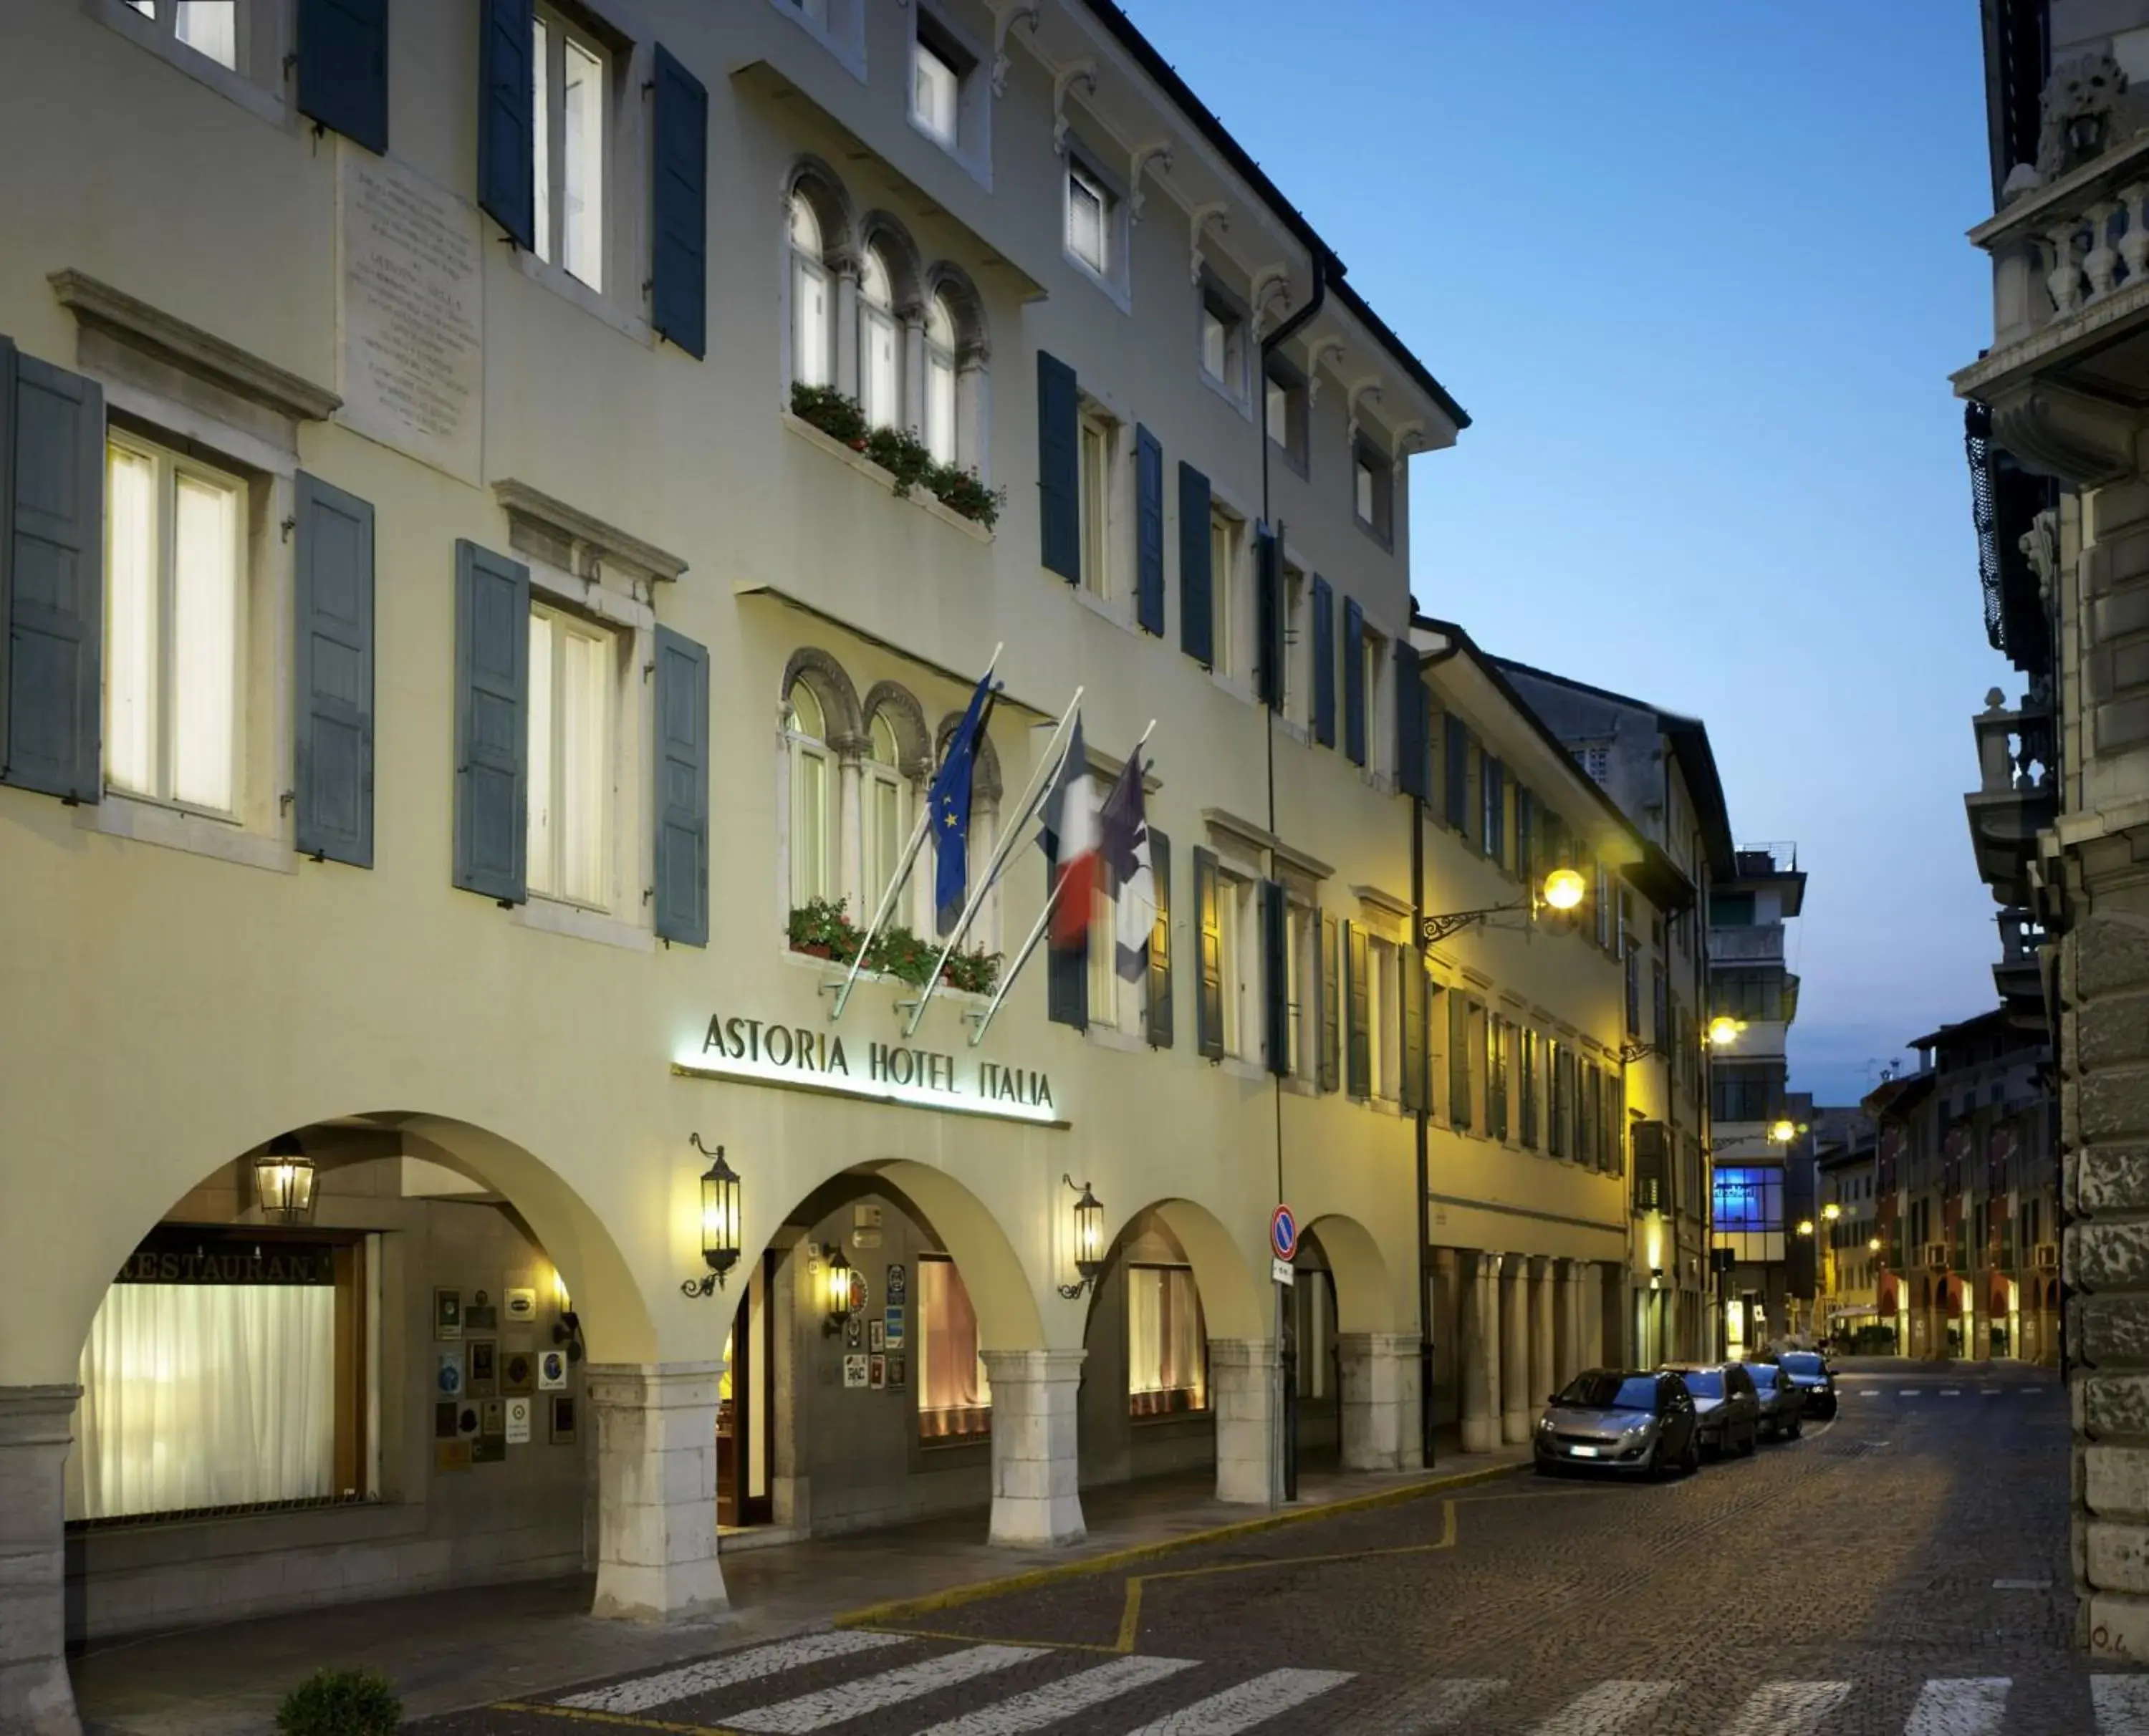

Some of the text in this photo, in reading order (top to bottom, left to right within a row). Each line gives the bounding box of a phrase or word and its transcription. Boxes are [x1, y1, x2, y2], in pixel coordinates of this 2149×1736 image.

[702, 1013, 1053, 1109] ASTORIA HOTEL ITALIA
[114, 1251, 316, 1282] ESTAURAN
